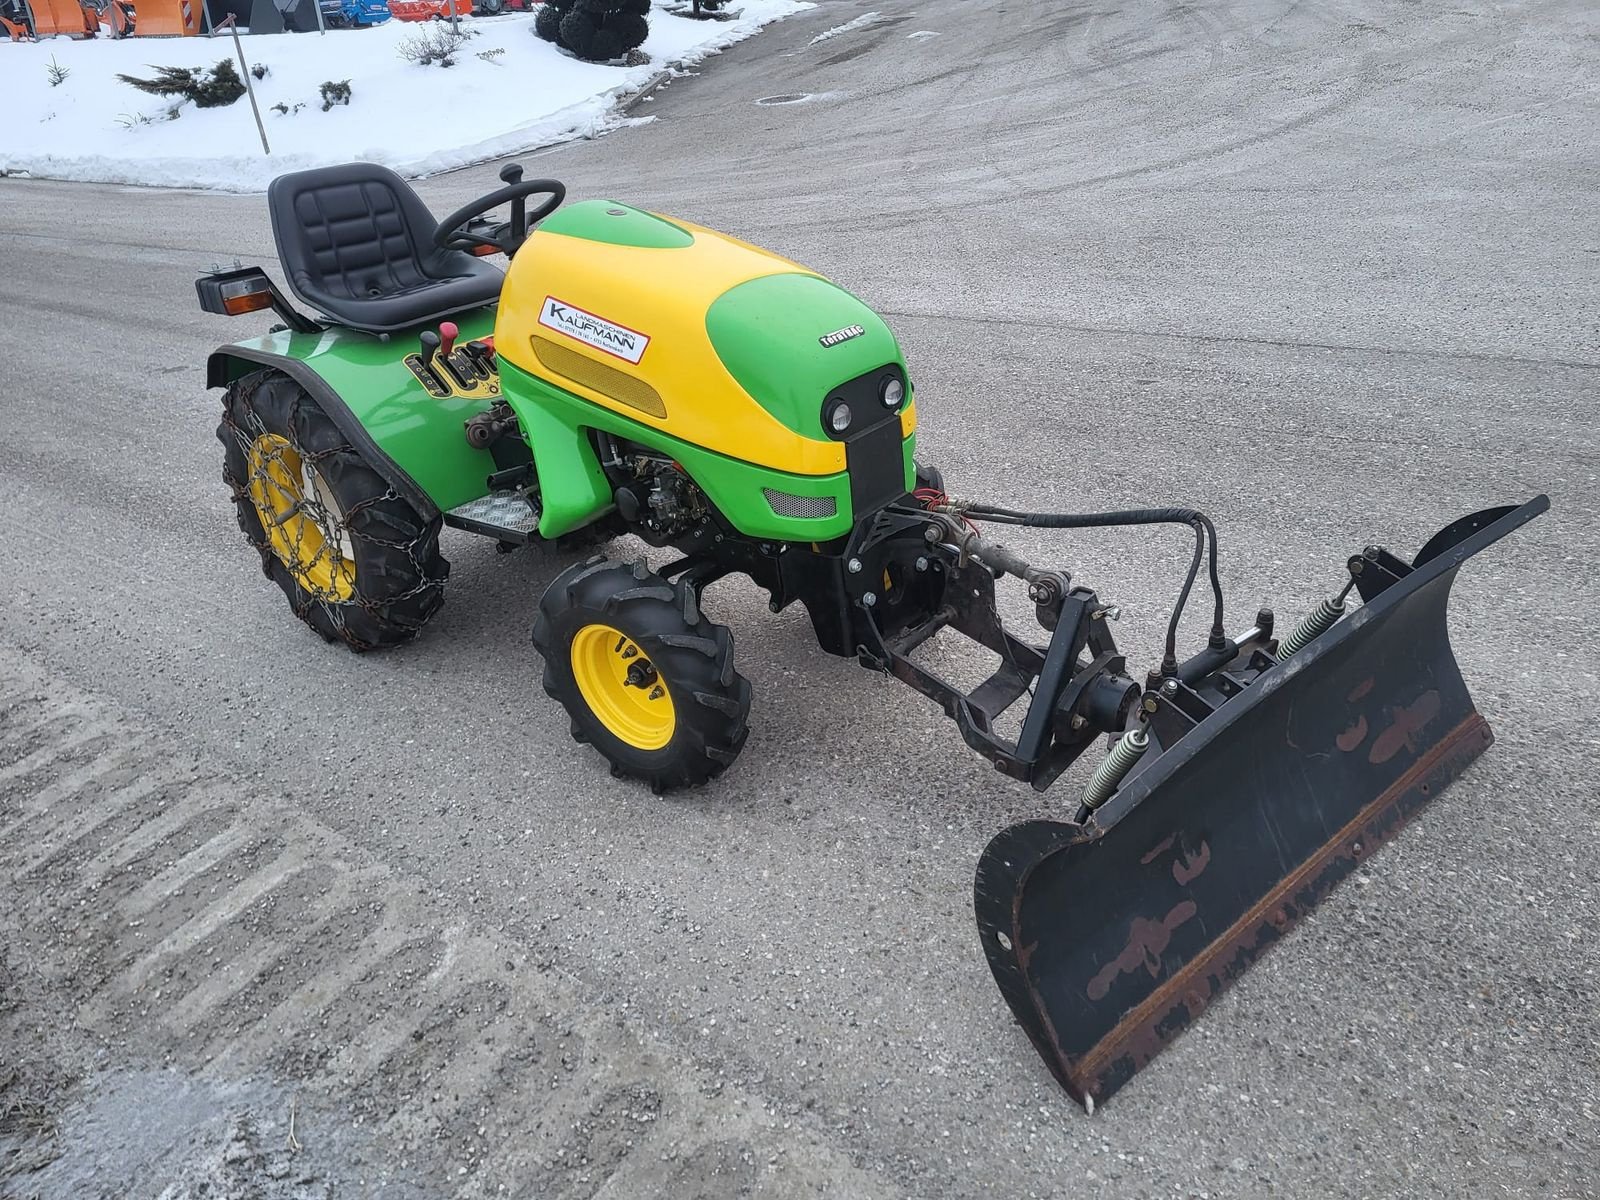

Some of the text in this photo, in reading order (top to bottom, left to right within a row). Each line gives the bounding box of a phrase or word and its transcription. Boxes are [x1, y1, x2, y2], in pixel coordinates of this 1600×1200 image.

[550, 303, 635, 350] KAUFMANN
[575, 312, 636, 341] LANDMASCHINEN
[820, 325, 864, 346] TeraTRAC
